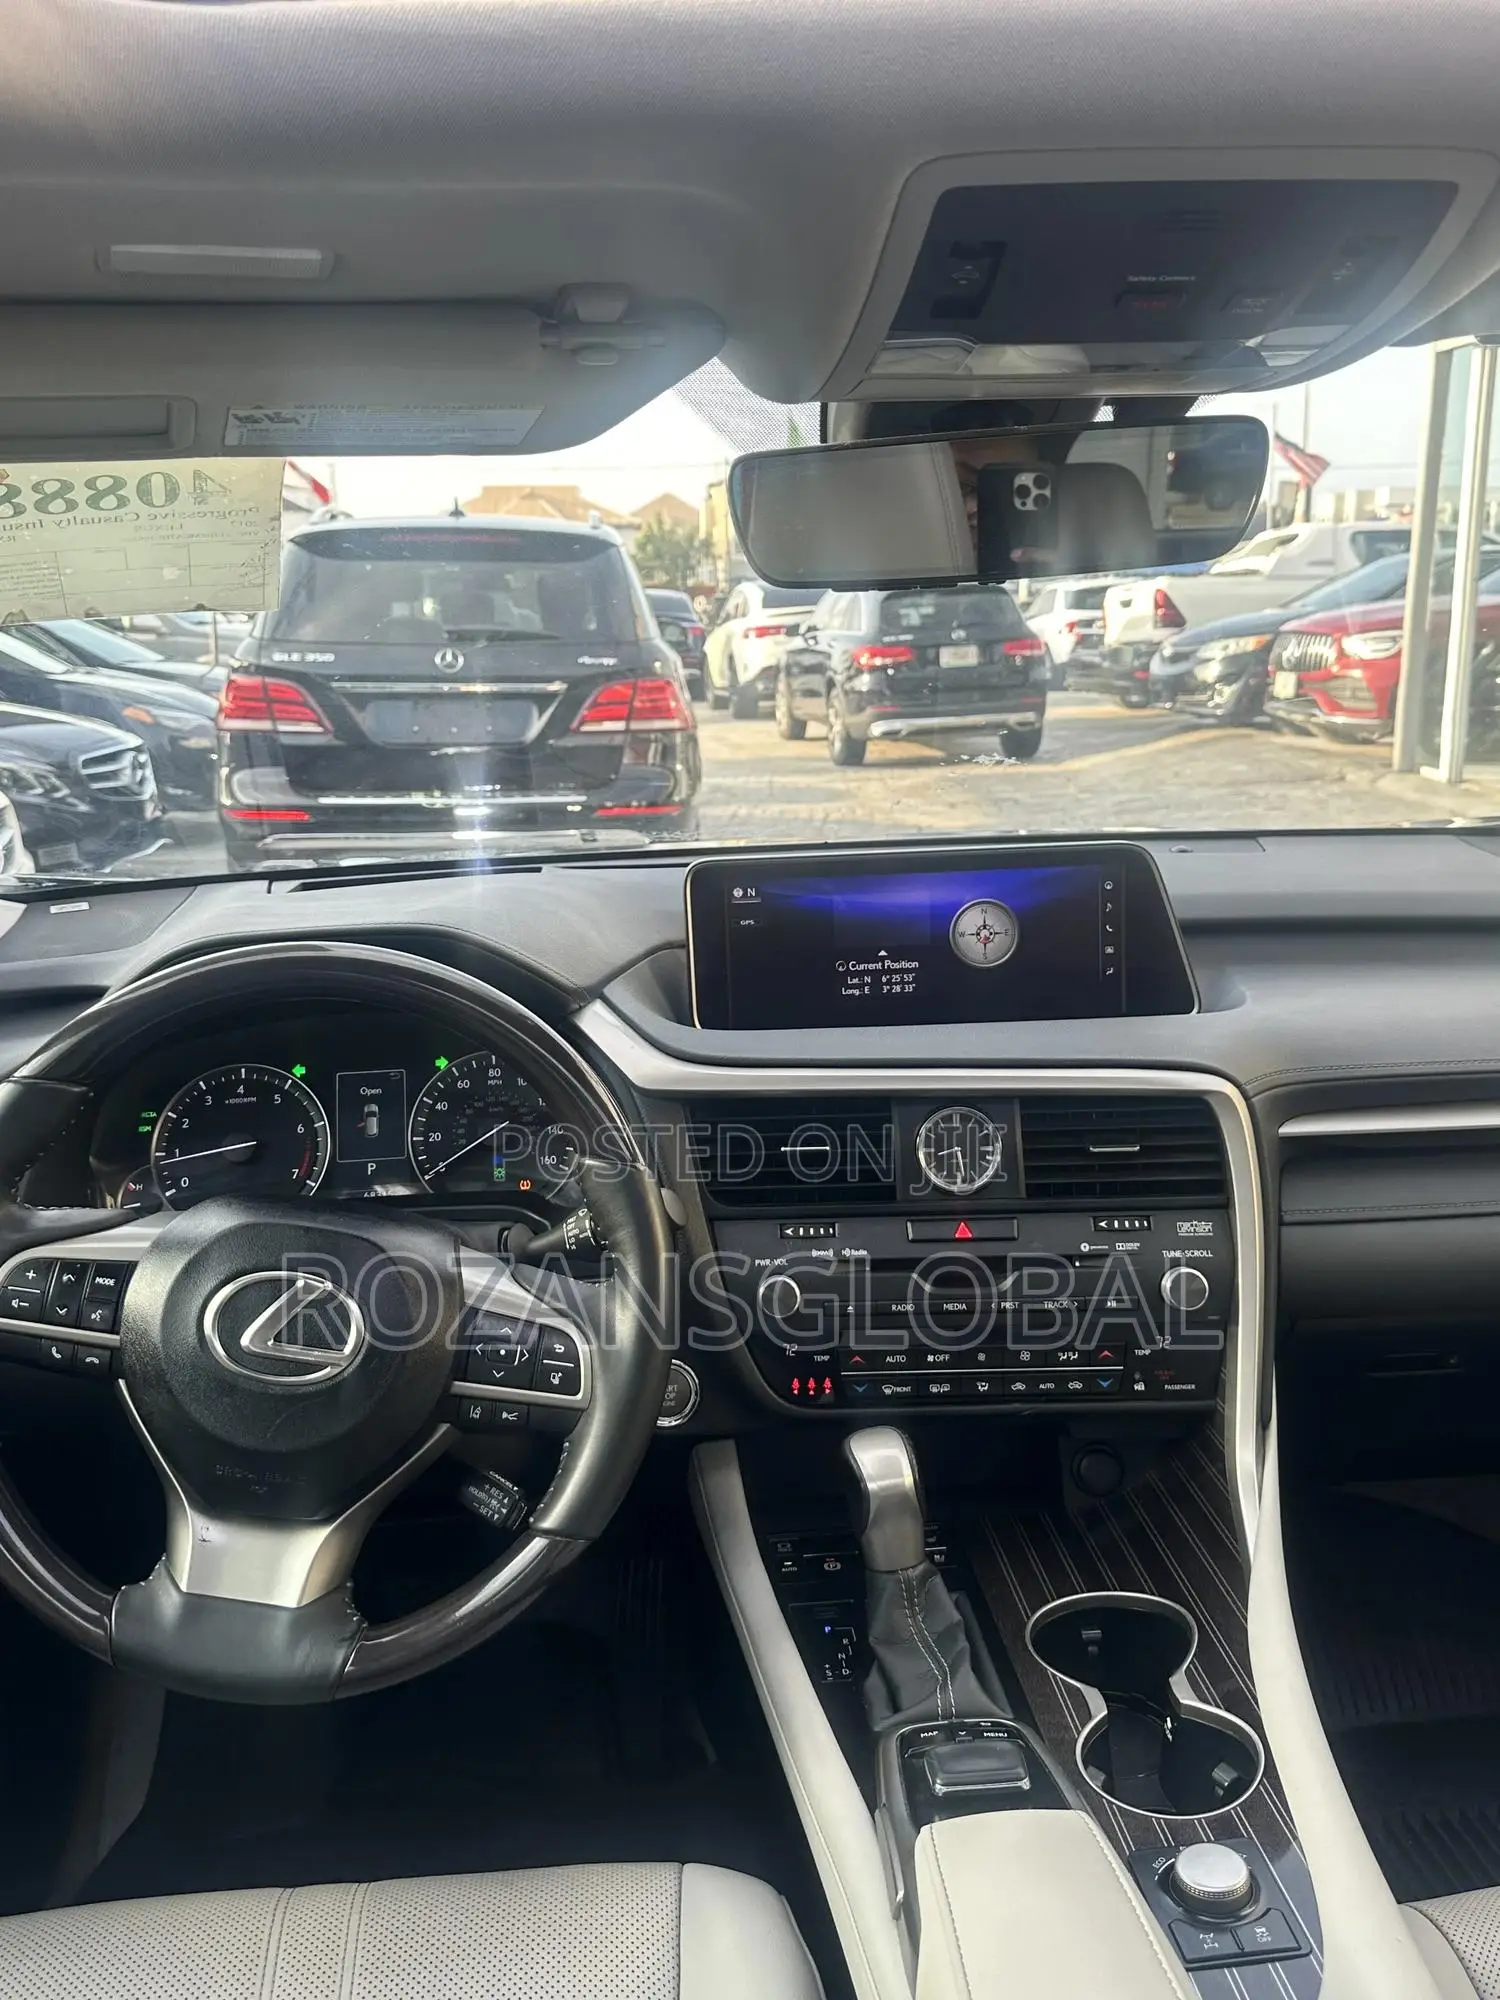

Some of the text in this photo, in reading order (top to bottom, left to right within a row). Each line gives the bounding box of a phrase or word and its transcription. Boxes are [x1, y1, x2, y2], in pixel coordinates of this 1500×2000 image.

[748, 887, 756, 897] N
[848, 959, 919, 971] Current Position
[488, 1067, 501, 1077] 80
[457, 1079, 470, 1089] 60
[237, 1085, 245, 1095] 4
[360, 1086, 382, 1097] Open
[204, 1096, 212, 1106] 3
[274, 1094, 281, 1104] 5
[435, 1101, 448, 1111] 40
[182, 1118, 190, 1129] 2
[297, 1123, 305, 1134] 6
[428, 1132, 441, 1142] 20
[540, 1155, 557, 1165] 160
[367, 1162, 376, 1175] P
[291, 1169, 299, 1179] 7
[181, 1177, 189, 1187] 0
[135, 1183, 143, 1192] H
[95, 1276, 116, 1286] MODE
[891, 1303, 967, 1311] RADIO MEDIA
[1000, 1301, 1069, 1310] PRST TRACK
[1155, 1335, 1172, 1349] 72
[783, 1343, 798, 1356] 72
[1134, 1348, 1151, 1356] TEMP
[885, 1354, 950, 1363] AUTO OFF
[893, 1385, 912, 1393] FRONT
[1038, 1382, 1055, 1390] AUTO
[479, 1503, 494, 1518] SET
[824, 1625, 832, 1634] P
[842, 1637, 850, 1645] R
[838, 1652, 846, 1660] N
[825, 1667, 850, 1677] S D
[920, 1730, 939, 1739] MAP
[1152, 1856, 1166, 1869] ECO
